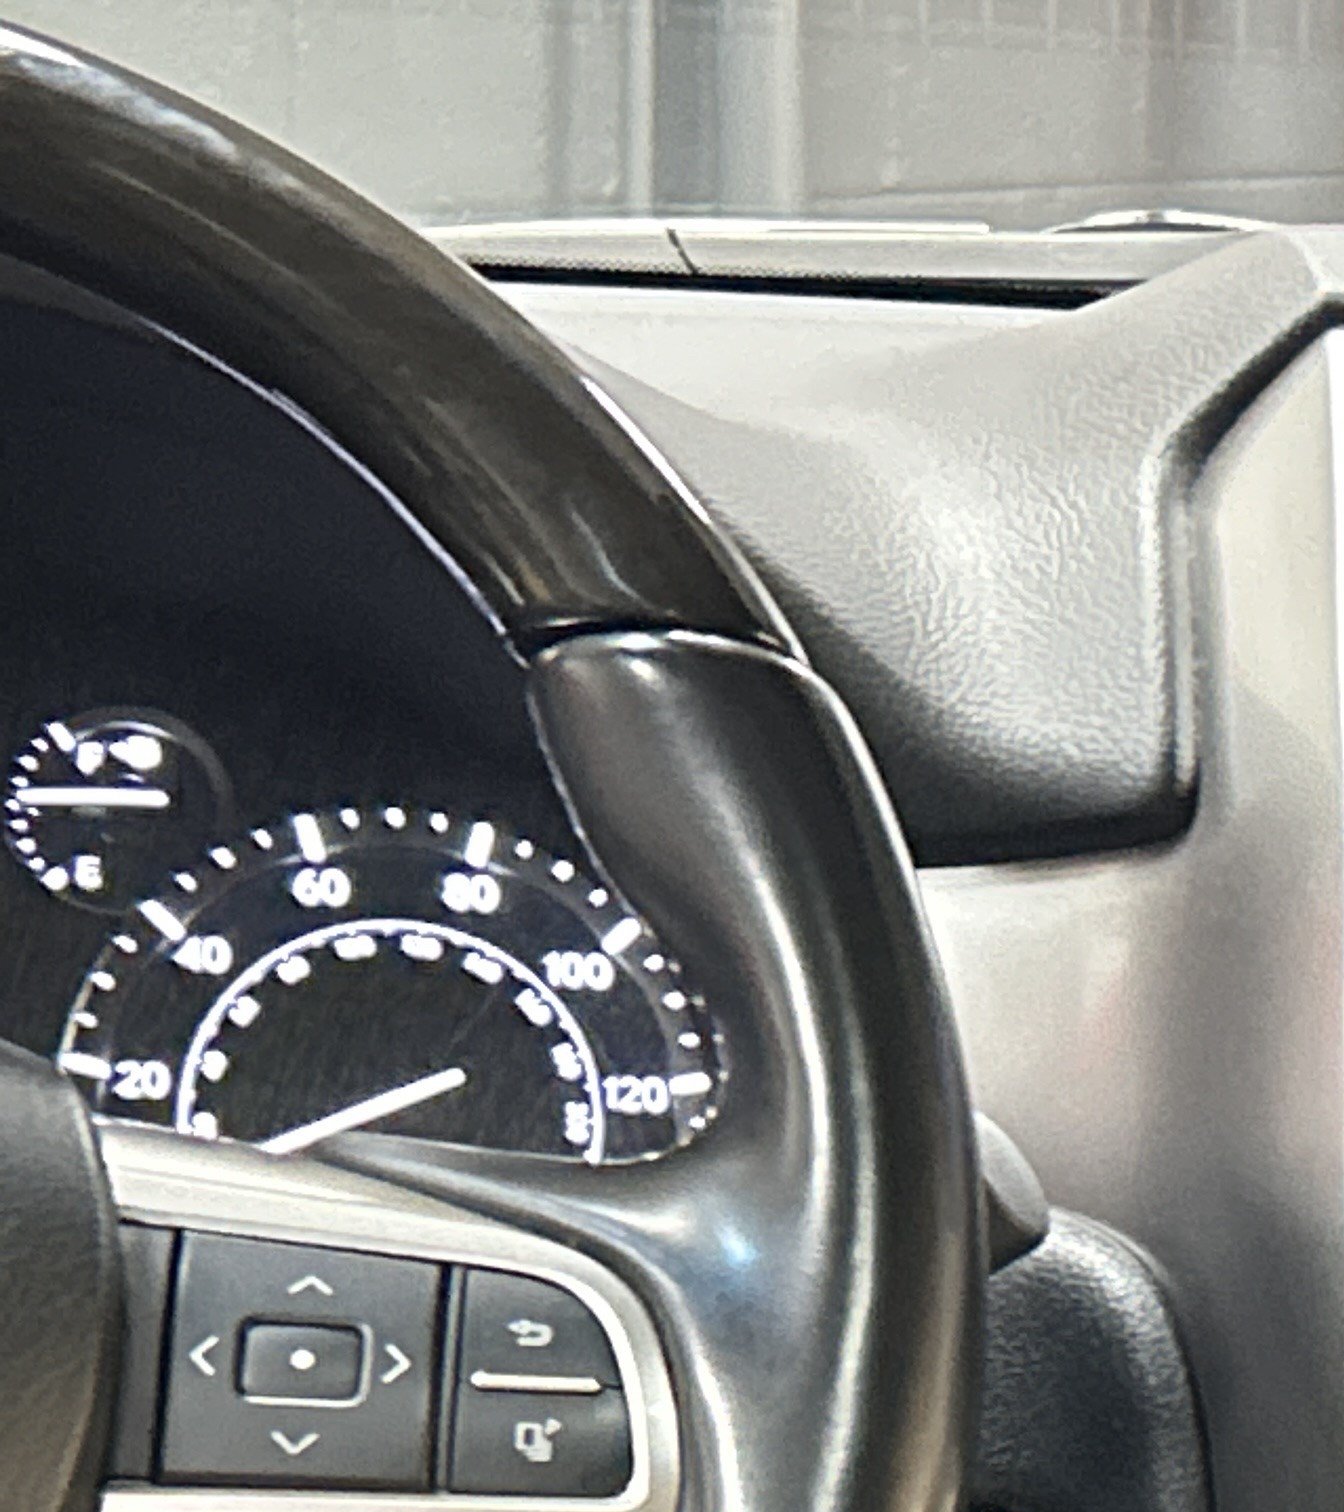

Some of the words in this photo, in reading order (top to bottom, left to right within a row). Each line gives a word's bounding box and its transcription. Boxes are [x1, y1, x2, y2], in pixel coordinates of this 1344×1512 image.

[74, 855, 103, 890] E
[292, 870, 351, 907] 60
[442, 868, 500, 912] 80
[176, 934, 232, 976] 40
[541, 949, 612, 991] 100
[113, 1060, 171, 1101] 20
[606, 1074, 668, 1112] 120
